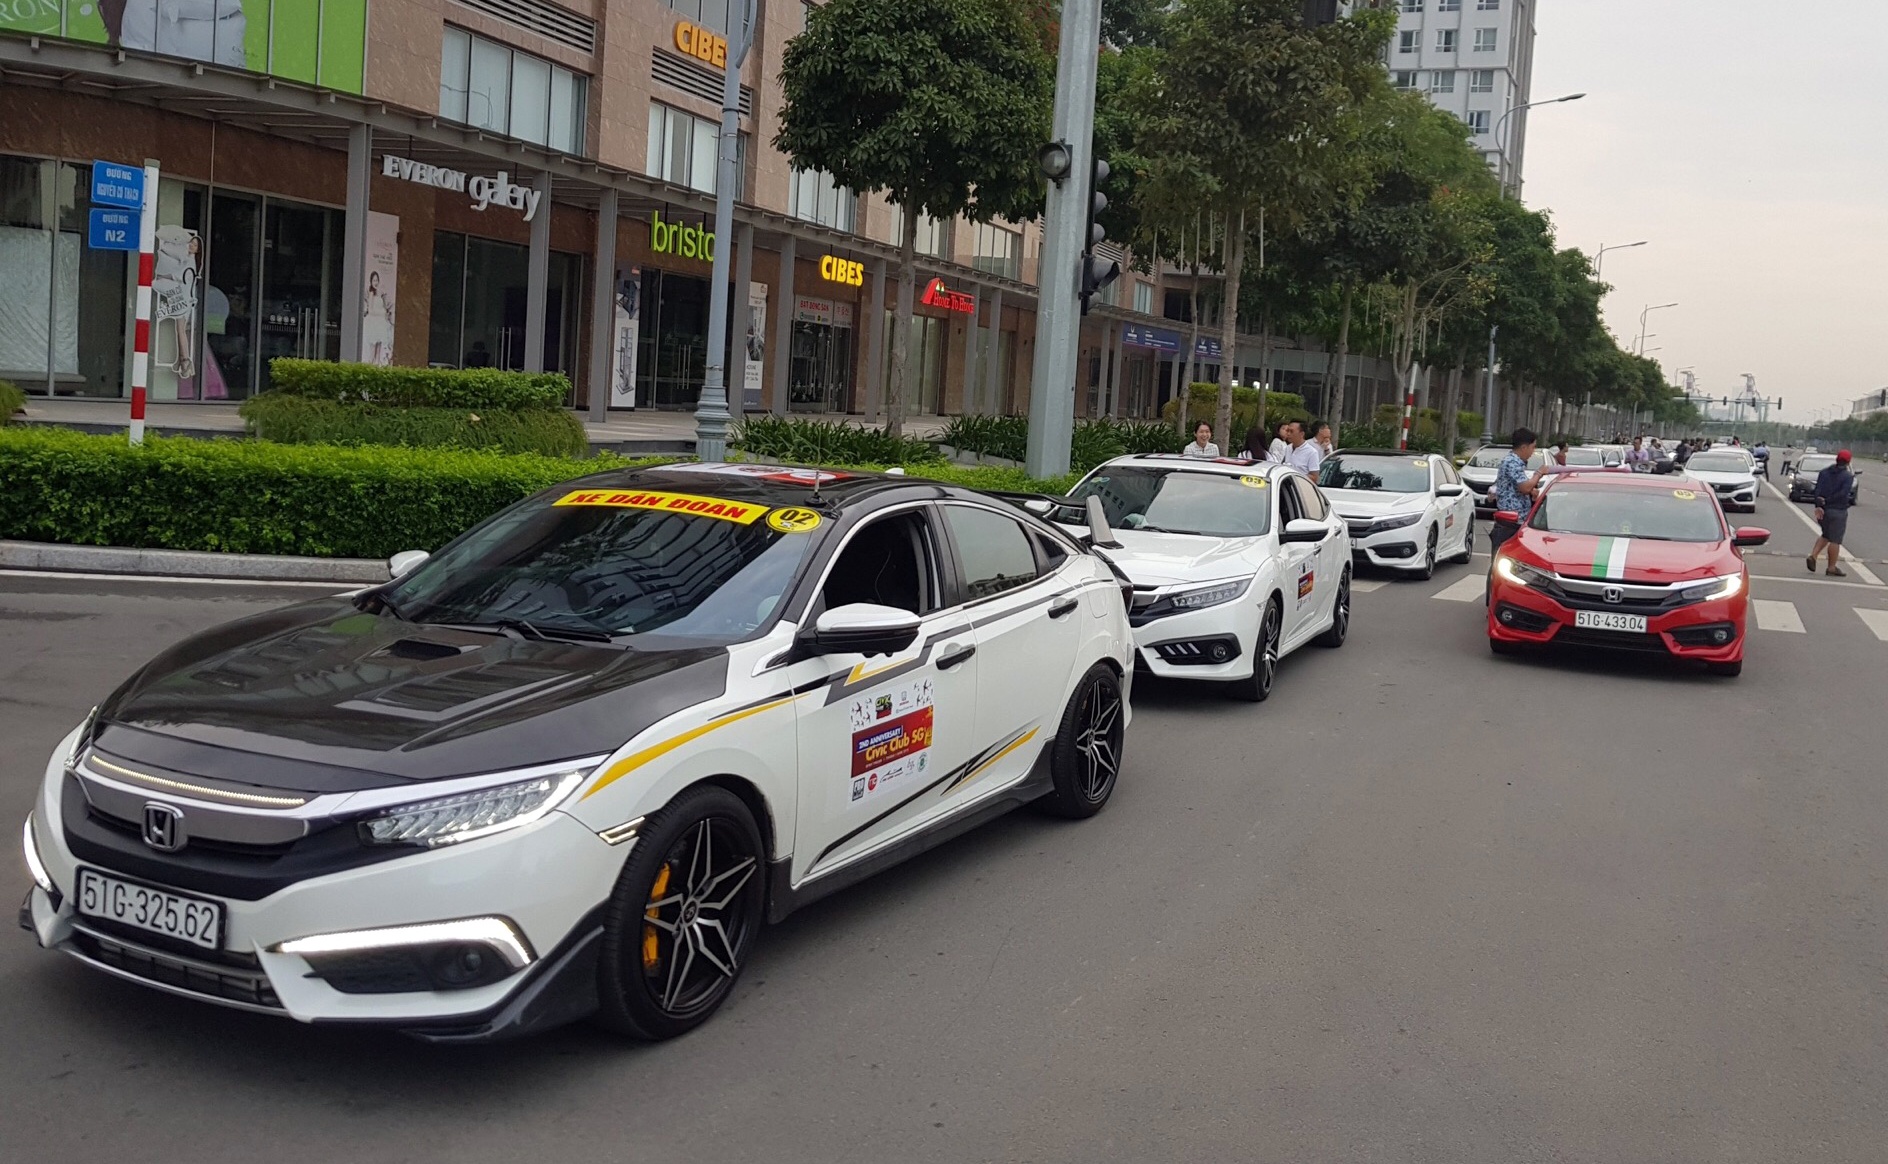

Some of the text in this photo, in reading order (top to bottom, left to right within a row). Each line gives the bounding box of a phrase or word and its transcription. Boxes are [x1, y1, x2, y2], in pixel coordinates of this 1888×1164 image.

[673, 21, 728, 71] CIBE
[381, 154, 467, 193] EVERON
[105, 229, 126, 242] N2
[819, 254, 864, 287] CIBES
[568, 493, 603, 503] XE
[779, 509, 815, 526] 02
[1577, 612, 1644, 630] 51G-433.04
[865, 742, 888, 761] Civic
[889, 732, 910, 752] Club
[911, 727, 925, 744] SG
[870, 727, 901, 745] ANNIVERSARY
[84, 875, 214, 943] 51G-325.62
